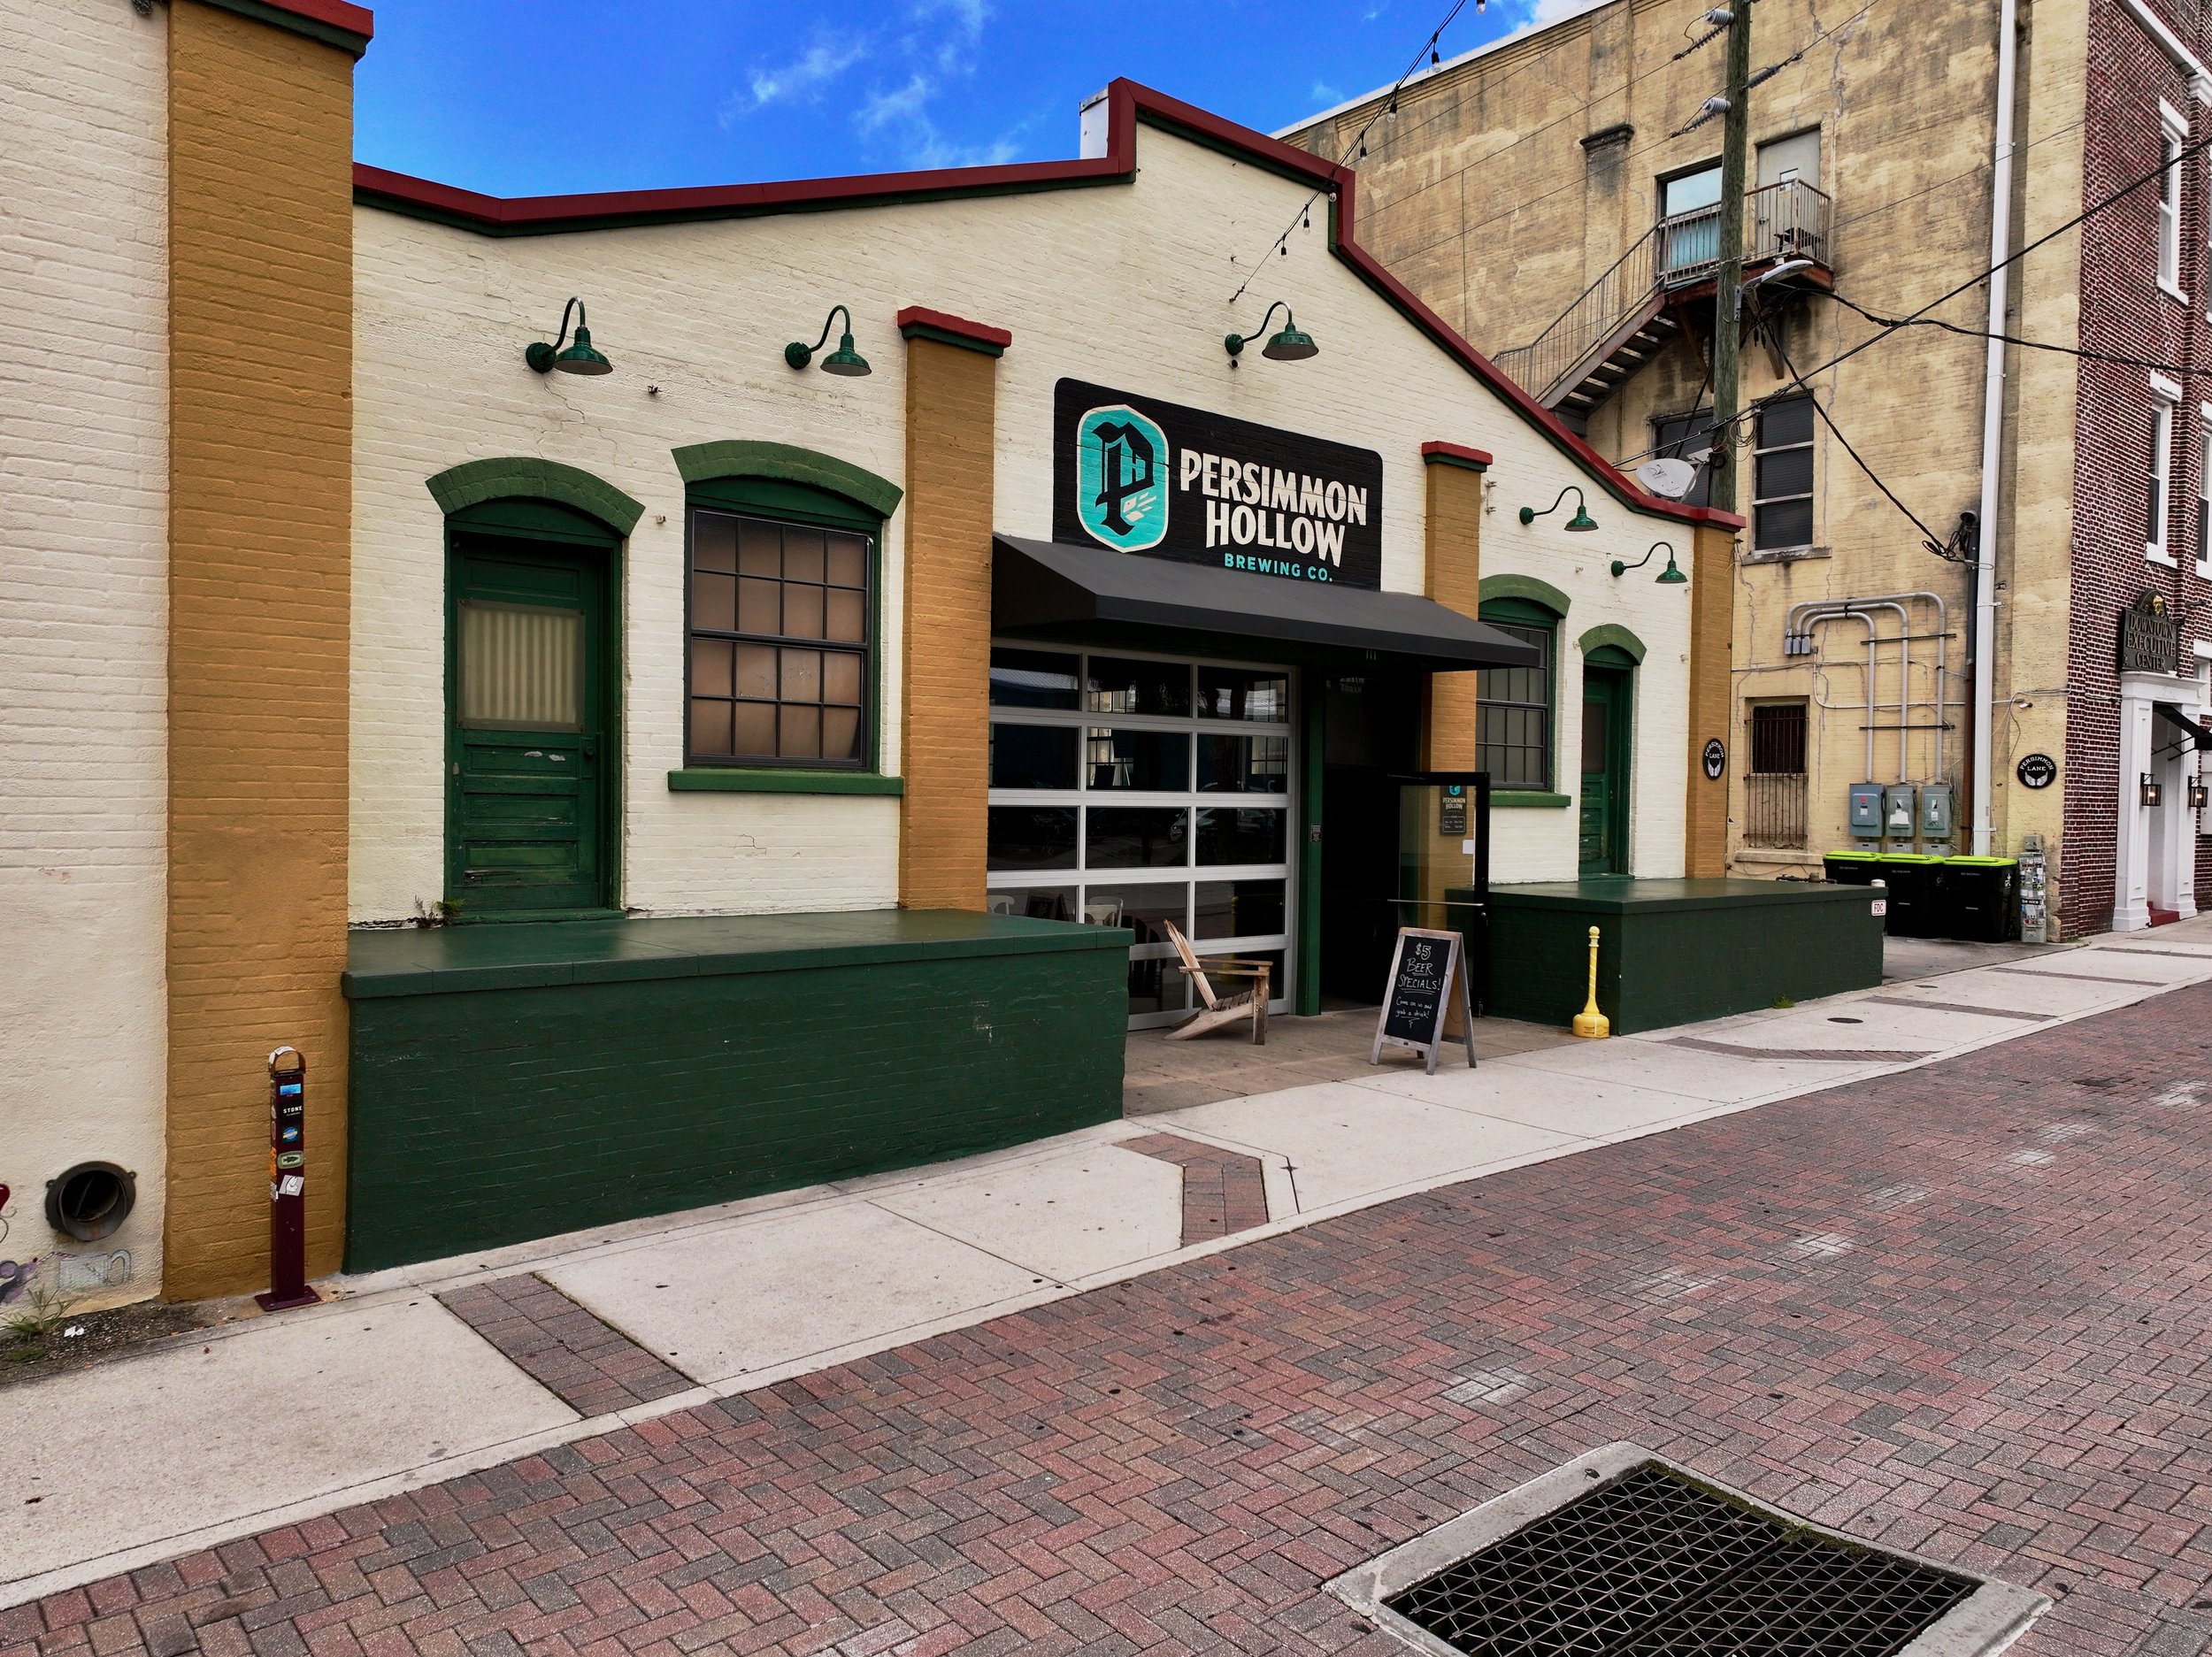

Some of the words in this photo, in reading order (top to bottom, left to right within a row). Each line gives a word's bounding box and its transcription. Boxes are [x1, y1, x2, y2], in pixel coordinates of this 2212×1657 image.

[1181, 448, 1367, 525] PERSIMMON
[1206, 500, 1346, 567] HOLLOW
[1224, 553, 1301, 577] BREWING
[1307, 565, 1333, 582] CO.
[2131, 614, 2173, 639] DOWNTOWN
[2127, 632, 2176, 656] EXECUTIVE
[2137, 653, 2165, 671] CENTER
[2020, 756, 2054, 770] PERSIMMON
[1874, 903, 1884, 912] FDC
[1415, 942, 1432, 961] $5
[1406, 957, 1433, 975] BEER
[1398, 974, 1441, 991] SPECIALS!
[1396, 996, 1409, 1006] Come
[283, 1105, 303, 1114] STONE
